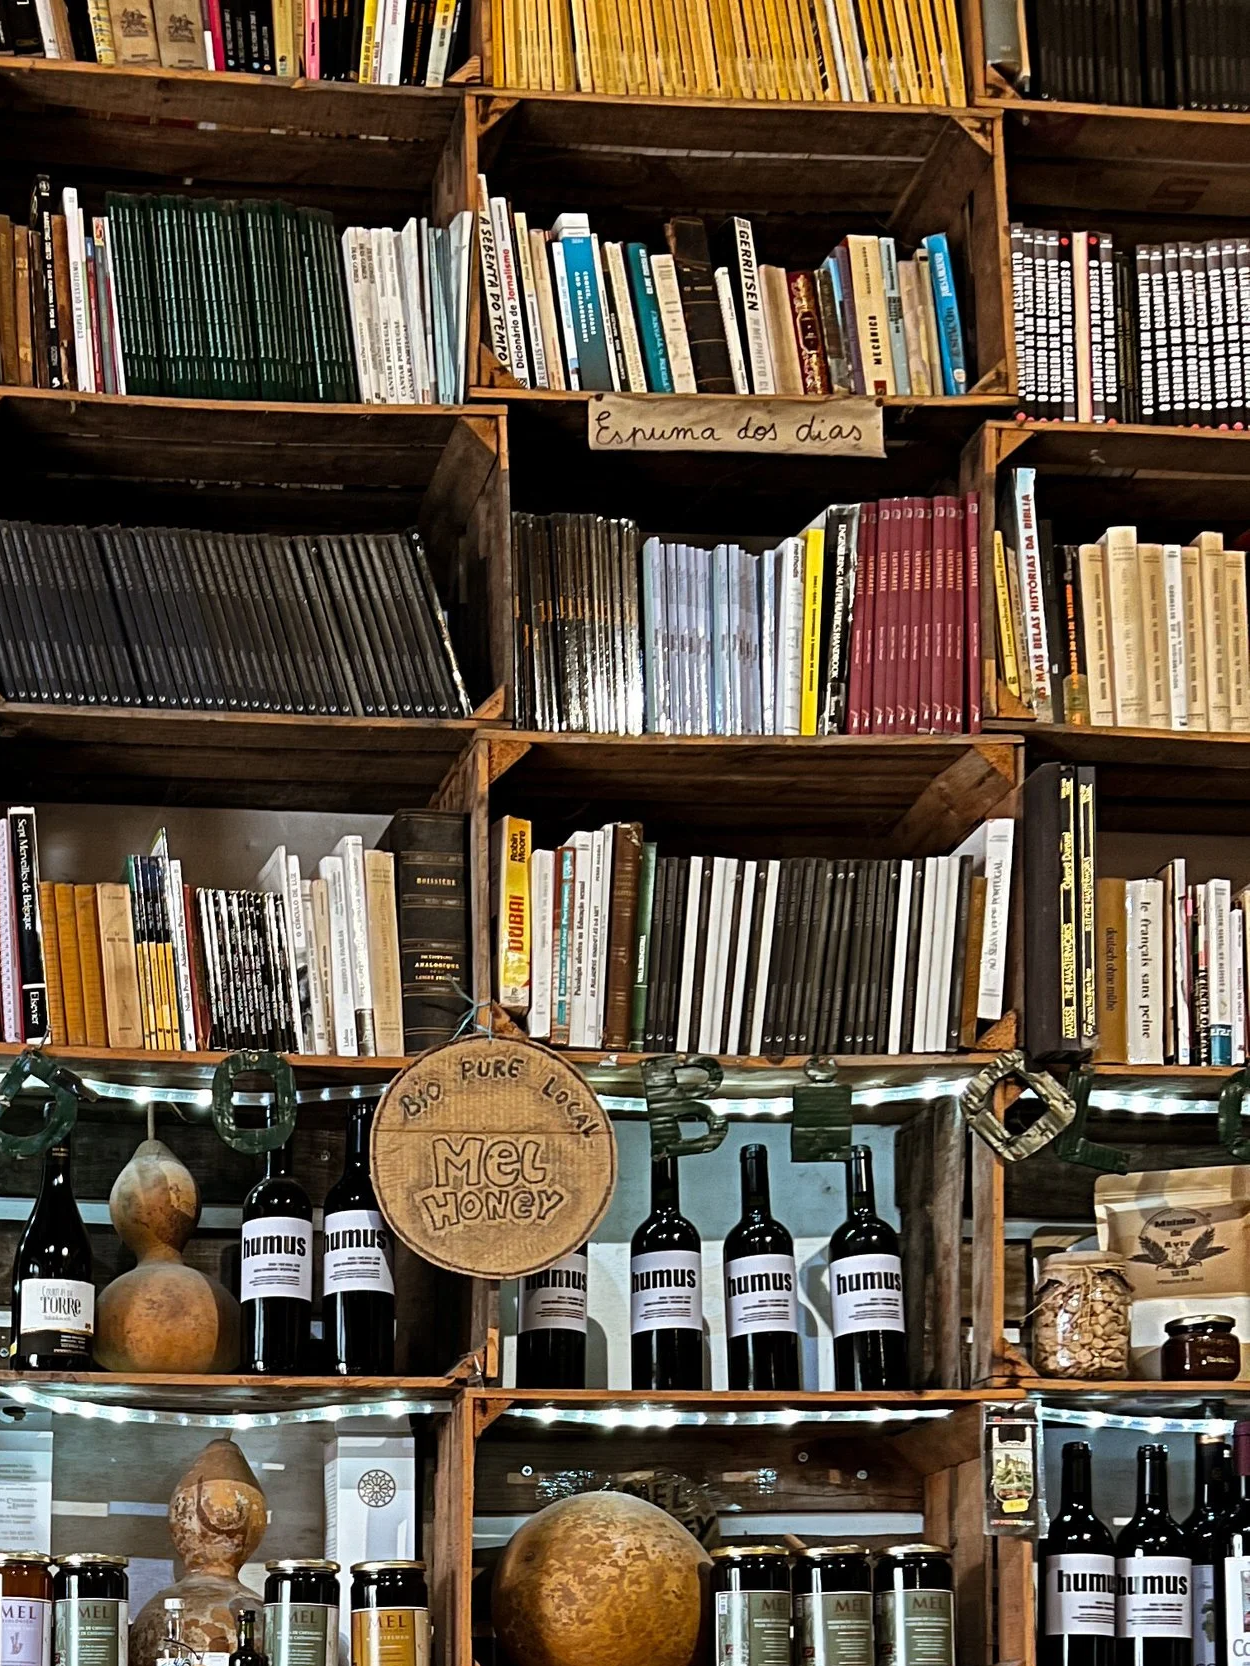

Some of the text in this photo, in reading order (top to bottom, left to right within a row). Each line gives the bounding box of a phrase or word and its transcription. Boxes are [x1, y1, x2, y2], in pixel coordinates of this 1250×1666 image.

[737, 229, 760, 312] GERRITSEN
[480, 216, 509, 362] A SEBENTA DO TEMPO
[1101, 261, 1115, 319] CASAMENTO
[1138, 272, 1151, 330] CASAMENTO
[501, 248, 525, 369] Dicionário Jornalismo
[1060, 260, 1075, 403] SEGREDO CASAMENTO
[1089, 259, 1105, 402] SEGREDO CASAMENTO
[595, 410, 863, 448] Espuma dos dias
[1021, 493, 1046, 684] MAIS BELAS HISTÓRIAS DA BÍBLIA
[510, 832, 519, 862] Robin
[517, 830, 526, 863] Moore
[17, 818, 33, 931] Sept Merveilles de Belgique
[508, 895, 525, 952] DUBAI
[574, 902, 586, 997] Psicologia Educação
[1107, 926, 1118, 982] deutsch ohne
[1140, 900, 1152, 1040] le français sans peine
[29, 990, 40, 1026] Elsevier
[1063, 1006, 1076, 1039] MATISSE
[458, 1054, 526, 1082] PURE
[540, 1074, 602, 1139] LOCAL
[243, 1232, 306, 1258] humus
[323, 1227, 387, 1253] humus
[632, 1266, 697, 1292] humus
[728, 1273, 793, 1298] humus
[836, 1270, 902, 1295] humus
[1115, 1573, 1189, 1597] humus
[0, 1604, 38, 1620] MEL
[77, 1605, 111, 1619] MEL
[288, 1610, 319, 1624] MEL
[367, 1614, 408, 1628] MEL
[834, 1598, 867, 1613] MEL
[912, 1596, 946, 1611] MEL
